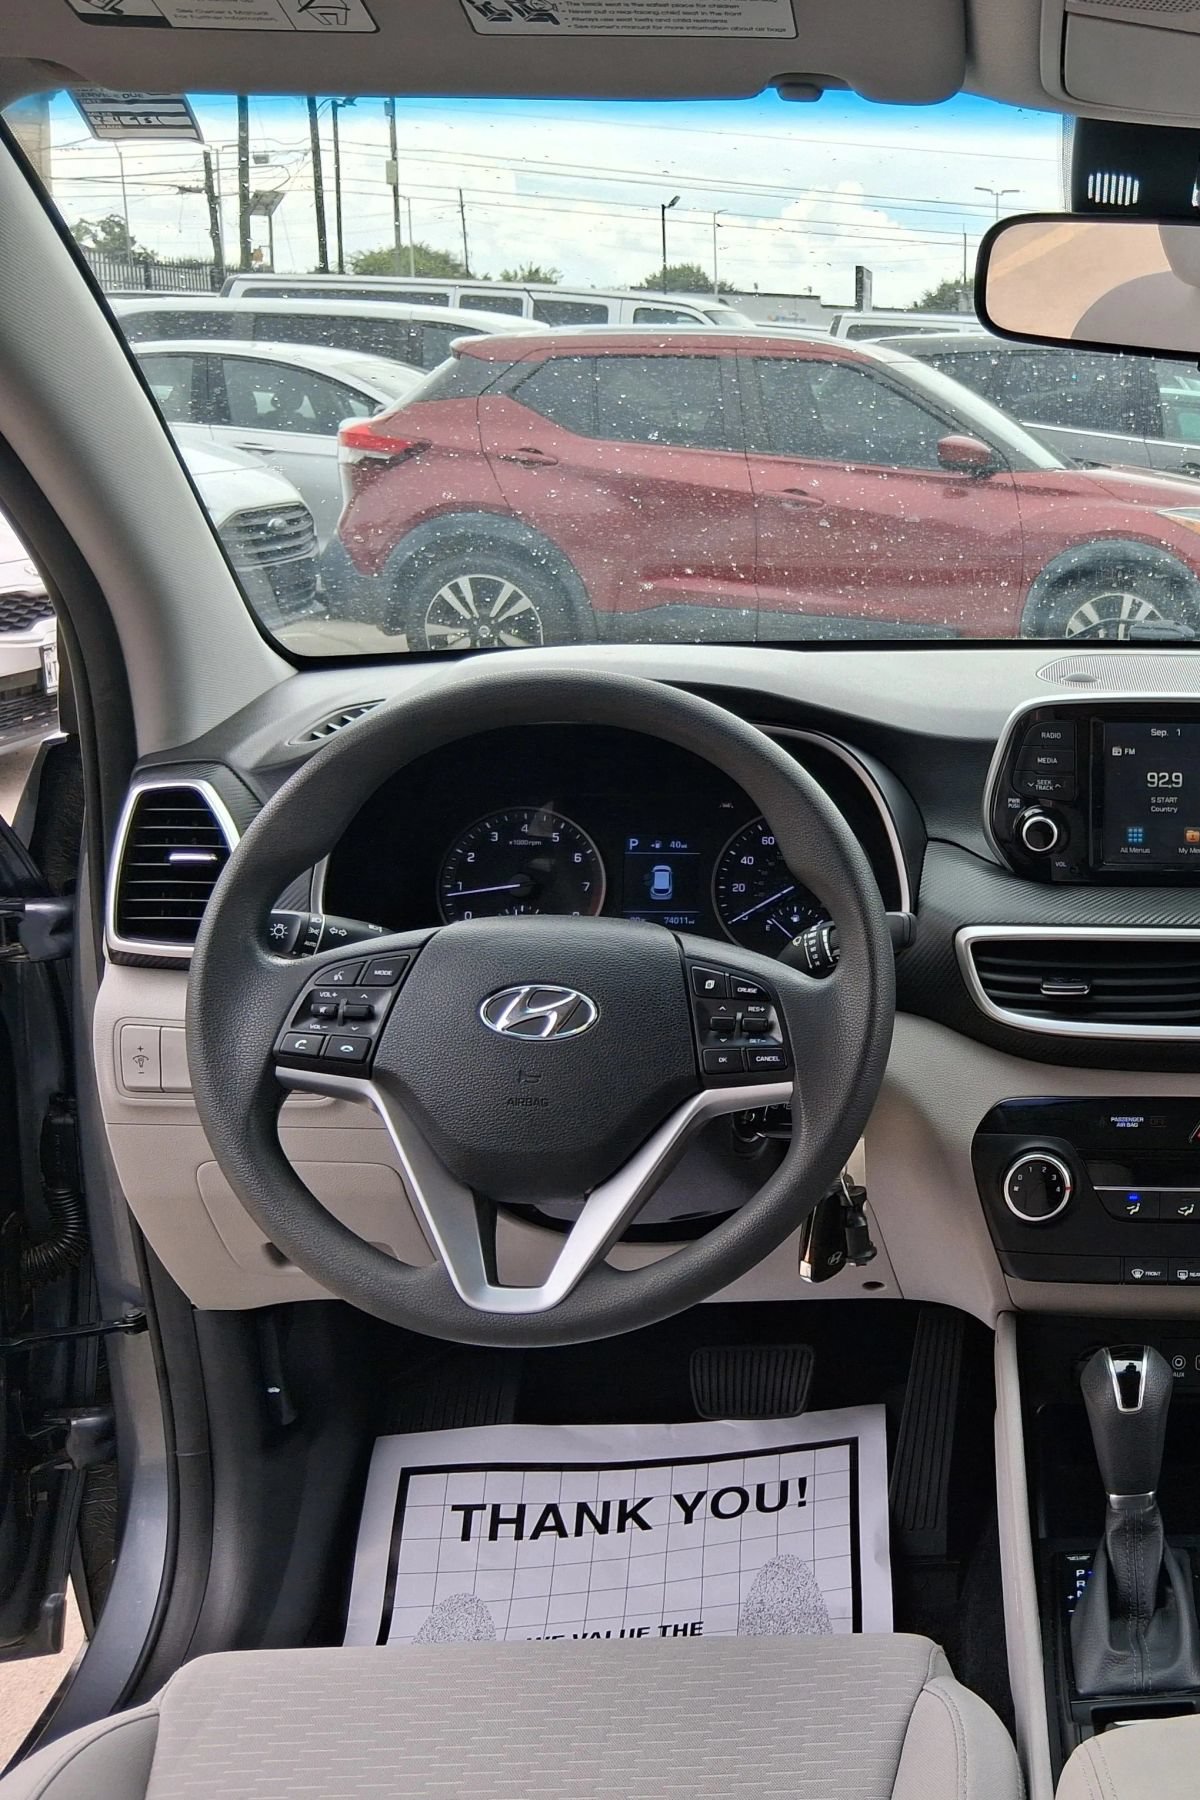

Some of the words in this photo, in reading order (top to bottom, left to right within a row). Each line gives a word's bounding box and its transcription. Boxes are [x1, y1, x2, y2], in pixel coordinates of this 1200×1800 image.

[1151, 728, 1168, 738] Sep.
[1146, 772, 1183, 788] 92.9
[1151, 806, 1178, 814] Country
[521, 824, 528, 832] 4
[491, 832, 498, 841] 3
[552, 832, 560, 842] 5
[761, 836, 775, 845] 60
[629, 838, 639, 850] P
[1179, 847, 1189, 855] My
[467, 852, 475, 862] 2
[574, 853, 582, 862] 6
[740, 856, 754, 865] 40
[583, 882, 590, 891] 7
[732, 884, 746, 892] 20
[508, 1098, 549, 1106] AIRBAG
[451, 1496, 655, 1543] THANK
[672, 1476, 810, 1526] YOU!
[1076, 1569, 1085, 1577] P
[1076, 1580, 1085, 1588] R
[657, 1621, 704, 1638] THE
